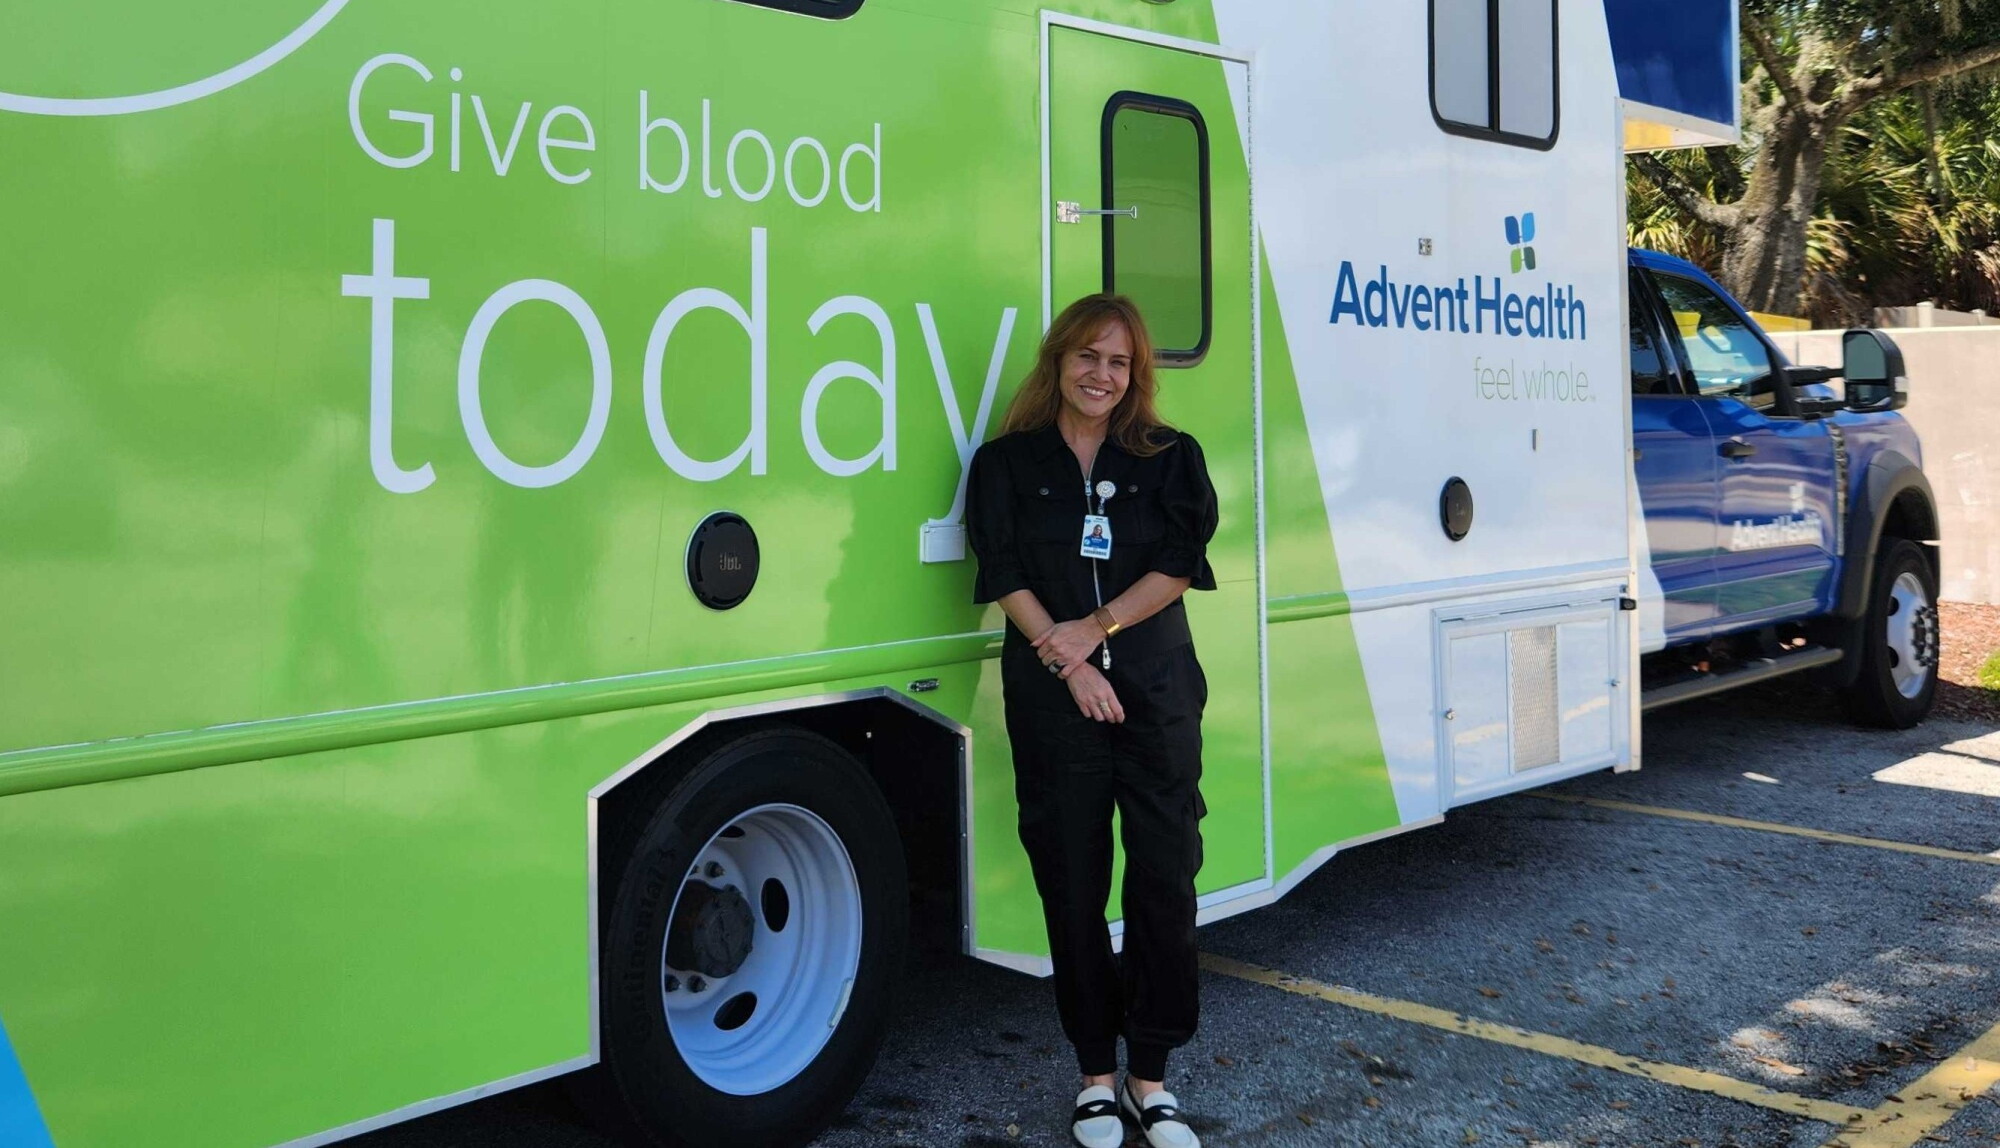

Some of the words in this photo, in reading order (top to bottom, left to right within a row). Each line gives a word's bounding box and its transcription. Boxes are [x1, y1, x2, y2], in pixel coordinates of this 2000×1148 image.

[348, 52, 596, 185] Give
[639, 89, 882, 214] blood
[1329, 260, 1587, 341] AdventHealth
[341, 218, 1018, 525] today
[1473, 356, 1518, 401] feel
[719, 551, 742, 571] JBL
